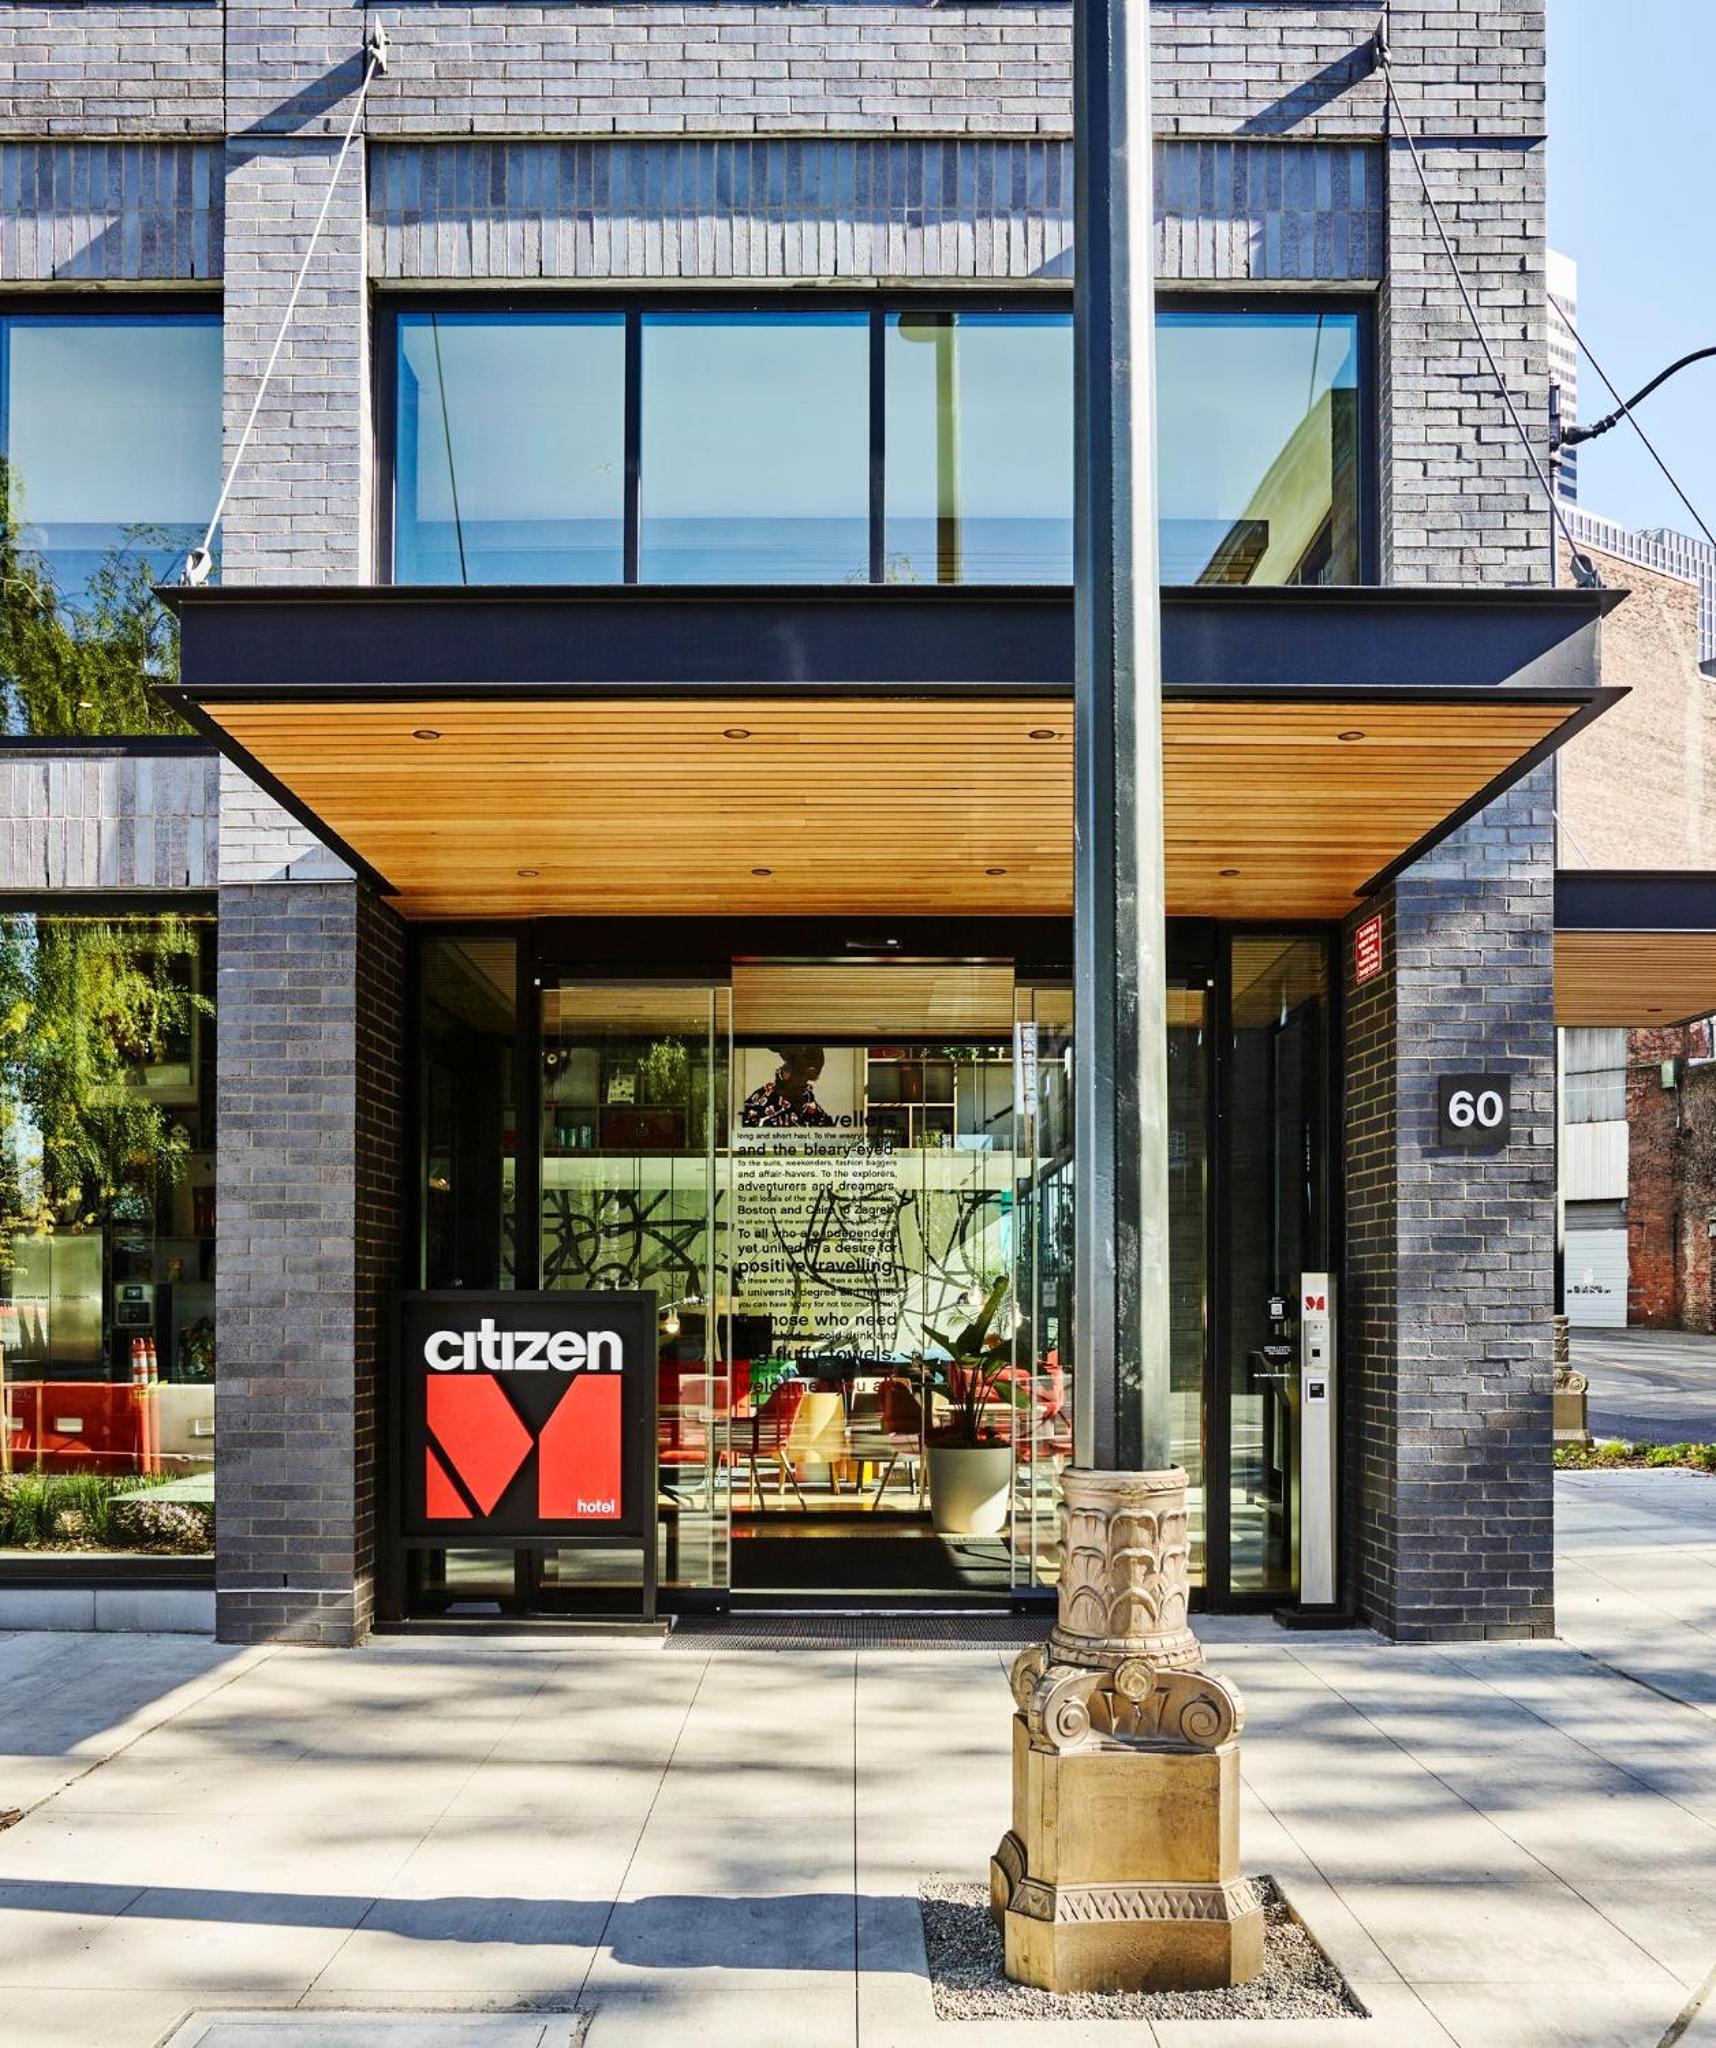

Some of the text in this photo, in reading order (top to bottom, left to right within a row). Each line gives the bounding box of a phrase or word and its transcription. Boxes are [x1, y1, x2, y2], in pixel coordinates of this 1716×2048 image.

[1449, 1090, 1504, 1128] 60
[756, 1132, 770, 1140] and
[772, 1132, 792, 1140] short
[739, 1143, 897, 1158] and the bleary-eyed.
[738, 1170, 755, 1178] and
[821, 1170, 831, 1178] To
[834, 1170, 849, 1178] the
[738, 1181, 807, 1191] adventurers
[811, 1181, 834, 1191] and
[738, 1205, 777, 1215] Boston
[780, 1205, 802, 1215] and
[738, 1228, 751, 1238] To
[754, 1228, 768, 1239] all
[800, 1230, 820, 1238] ae
[822, 1228, 898, 1241] ndependent
[738, 1243, 757, 1256] yet
[823, 1244, 831, 1253] a
[835, 1242, 876, 1253] desire
[879, 1242, 899, 1253] for
[739, 1258, 806, 1277] positive
[763, 1312, 809, 1326] hose
[815, 1312, 850, 1326] who
[856, 1312, 897, 1326] need
[877, 1331, 897, 1341] and
[424, 1318, 623, 1371] citizen
[828, 1345, 897, 1361] towels.
[576, 1499, 616, 1514] hotel
